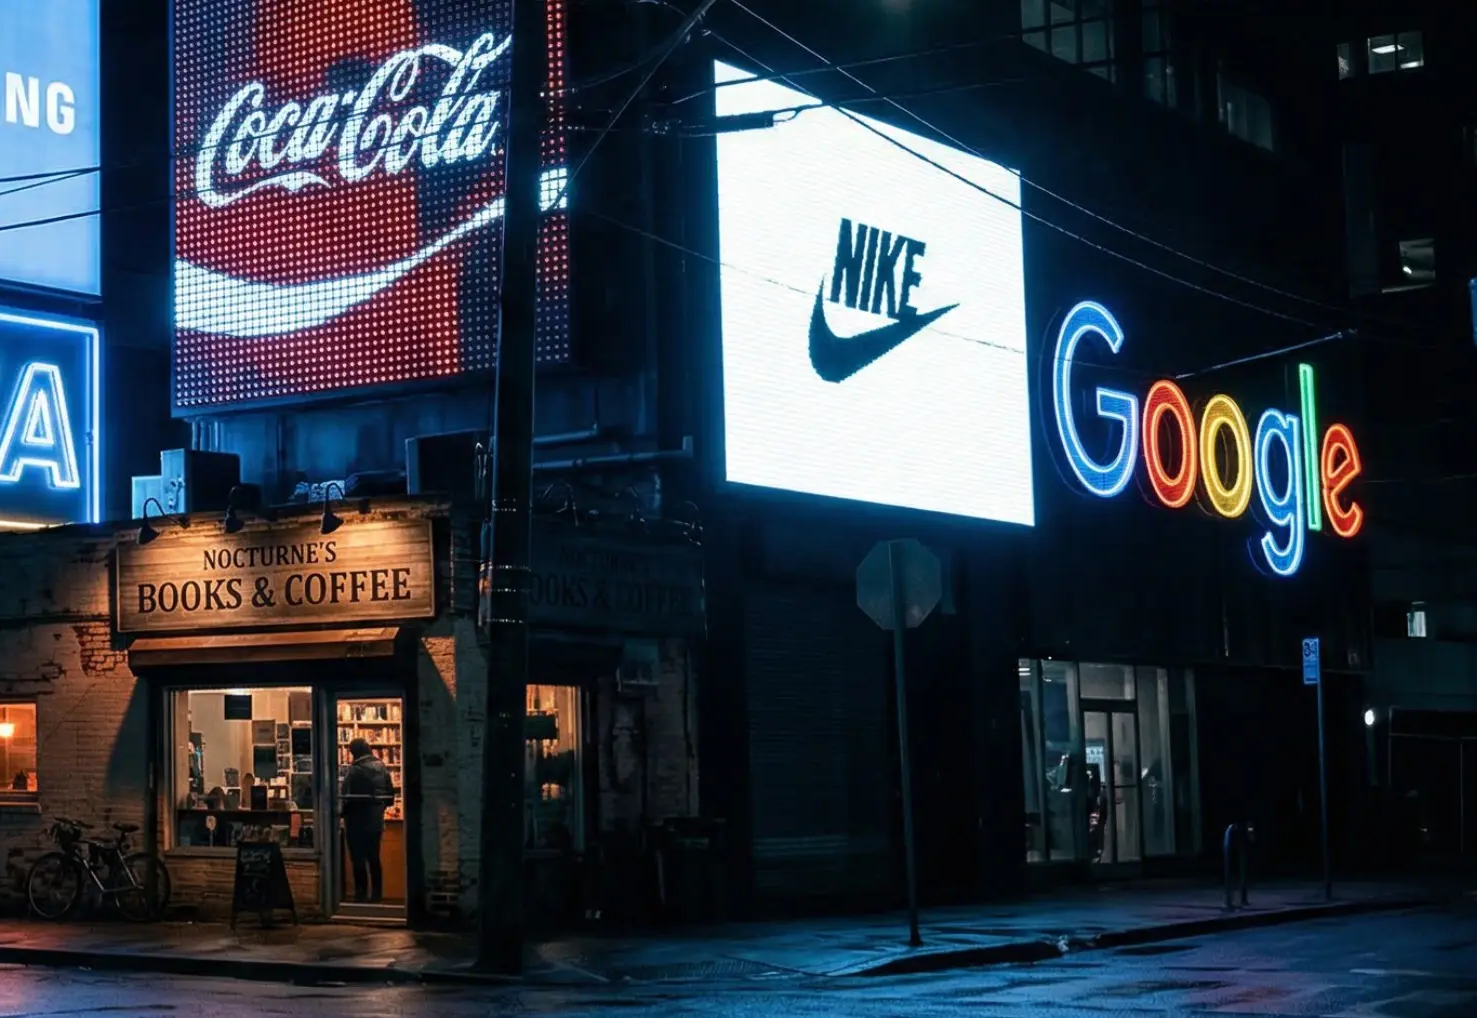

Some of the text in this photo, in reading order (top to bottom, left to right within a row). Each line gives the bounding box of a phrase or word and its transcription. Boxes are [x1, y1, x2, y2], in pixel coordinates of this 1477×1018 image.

[196, 32, 512, 209] Coca-Cola
[830, 217, 926, 321] NIKE
[1052, 300, 1363, 577] Google
[137, 567, 412, 614] BOOKS & COFFEE
[203, 541, 337, 571] NOCTURNE'S
[528, 573, 588, 607] OOKS
